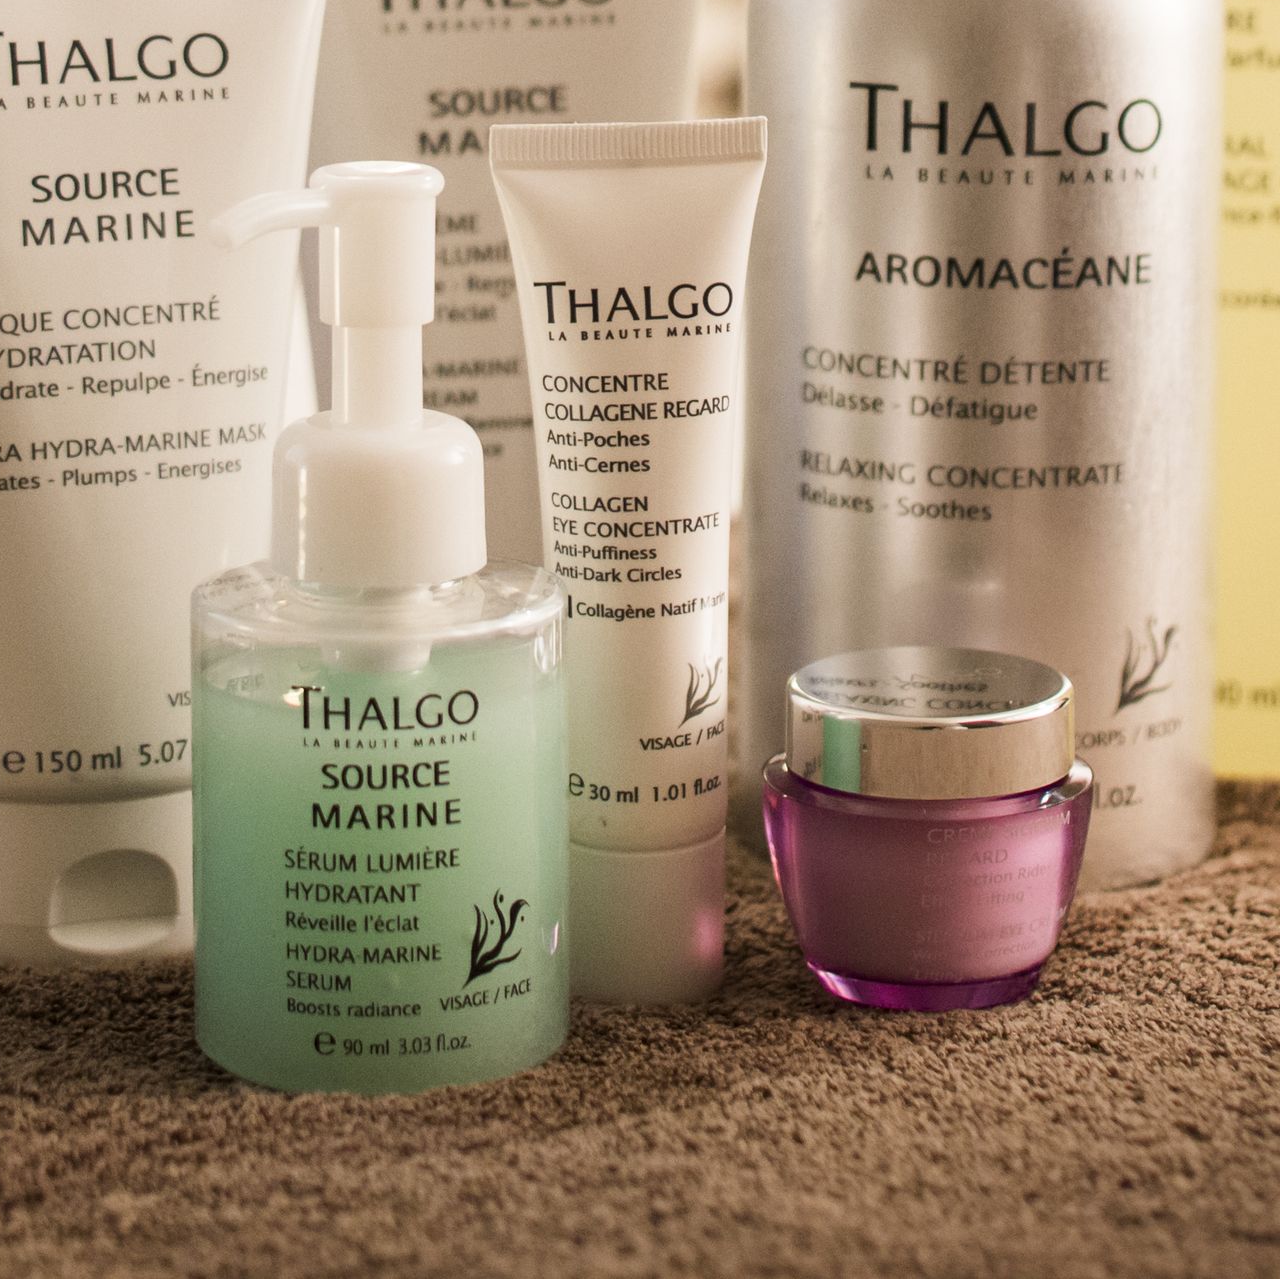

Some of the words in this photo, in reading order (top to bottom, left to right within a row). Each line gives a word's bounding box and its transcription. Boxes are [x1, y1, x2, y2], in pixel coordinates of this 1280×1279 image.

[26, 92, 120, 110] BEAUTE
[137, 86, 231, 105] MARINE
[427, 83, 568, 119] SOURCE
[849, 81, 1164, 158] THALGO
[31, 168, 181, 203] SOURCE
[866, 164, 895, 182] LA
[917, 167, 1035, 186] BEAUTE
[21, 209, 196, 247] MARINE
[855, 247, 1153, 291] AROMACÉANE
[62, 295, 221, 331] CONCENTRÉ
[533, 282, 734, 324] THALGO
[549, 331, 568, 342] LA
[580, 327, 654, 341] BEAUTE
[666, 323, 732, 338] MARINE
[801, 345, 968, 385] CONCENTRÉ
[979, 353, 1112, 386] DÉTENTE
[81, 371, 172, 398] Repulpe
[191, 363, 270, 389] Énergise
[542, 373, 670, 394] CONCENTRE
[545, 402, 659, 422] COLLAGENE
[663, 395, 731, 420] REGARD
[910, 394, 1039, 424] Défatigue
[30, 428, 212, 462] HYDRA-MARINE
[217, 422, 268, 446] MASK
[547, 429, 651, 448] Anti-Poches
[61, 467, 138, 492] Plumps
[157, 457, 243, 483] Energises
[549, 454, 651, 473] Anti-Cernes
[800, 449, 918, 486] RELAXING
[926, 462, 1127, 491] CONCENTRATE
[551, 492, 650, 513] COLLAGEN
[896, 495, 994, 523] Soothes
[552, 516, 580, 536] EYE
[583, 512, 721, 539] CONCENTRATE
[553, 540, 658, 561] Anti-Puffiness
[554, 562, 623, 584] Anti-Dark
[626, 566, 683, 584] Circles
[575, 601, 656, 623] Collagène
[660, 598, 697, 618] Natif
[167, 690, 192, 708] VIS
[291, 685, 479, 732] THALGO
[303, 736, 321, 748] LA
[333, 738, 401, 750] BEAUTE
[413, 730, 479, 748] MARINE
[639, 733, 693, 752] VISAGE
[706, 718, 726, 741] FACE
[34, 749, 84, 774] 150
[91, 744, 123, 771] ml
[138, 738, 189, 767] 5.07
[321, 760, 451, 791] SOURCE
[589, 785, 611, 803] 30
[616, 786, 640, 804] ml
[652, 781, 688, 803] 1.01
[311, 798, 462, 830] MARINE
[284, 846, 358, 873] SÉRUM
[366, 846, 461, 873] LUMIÈRE
[285, 881, 422, 906] HYDRATANT
[285, 911, 358, 933] Réveille
[363, 912, 421, 933] l'éclat
[286, 970, 353, 993] SERUM
[439, 988, 491, 1012] VISAGE
[503, 977, 533, 1000] FACE
[287, 997, 341, 1017] Boosts
[347, 1000, 422, 1018] radiance
[343, 1038, 364, 1057] 90
[369, 1035, 391, 1056] ml
[398, 1035, 432, 1056] 3.03
